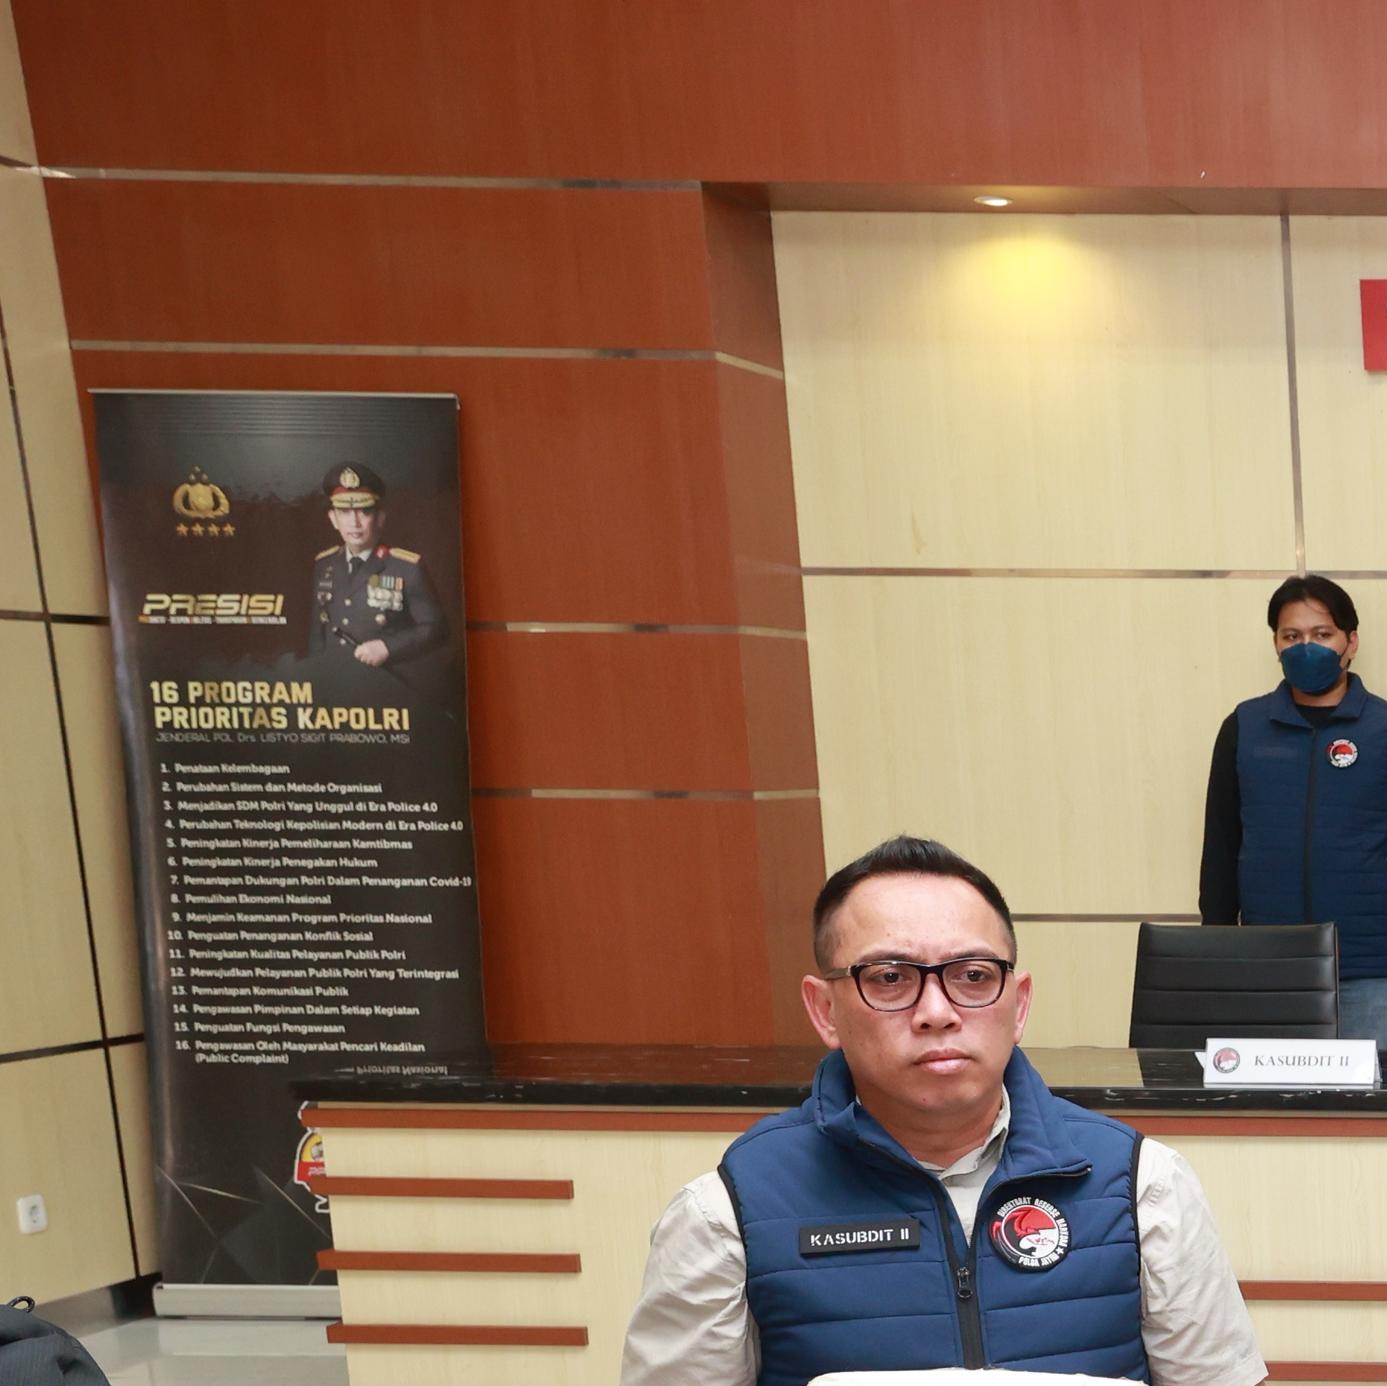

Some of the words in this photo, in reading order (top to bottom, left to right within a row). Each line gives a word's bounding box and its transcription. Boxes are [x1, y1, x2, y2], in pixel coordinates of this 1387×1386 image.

[143, 593, 284, 615] PRESISI
[150, 681, 179, 704] 16
[187, 681, 313, 704] PROGRAM
[154, 706, 288, 729] PRIORITAS
[297, 707, 410, 731] KAPOLRI
[287, 783, 326, 792] Metode
[327, 783, 382, 794] Organisasi
[261, 801, 286, 811] Polri
[287, 801, 313, 813] Yang
[315, 802, 354, 813] Unggul
[388, 802, 420, 812] Police
[245, 876, 299, 887] Dukungan
[301, 876, 325, 885] Polri
[327, 876, 360, 886] Dalam
[291, 913, 338, 924] Program
[339, 913, 384, 923] Prioritas
[385, 914, 432, 923] Nasional
[345, 950, 379, 959] Publik
[381, 950, 406, 960] Polri
[308, 968, 342, 978] Publik
[369, 969, 395, 980] Yang
[254, 1004, 305, 1016] Pimpinan
[306, 1005, 339, 1015] Dalam
[374, 1005, 420, 1017] Kegiatan
[340, 1042, 378, 1051] Pencari
[380, 1042, 425, 1052] Keadilan
[1254, 1055, 1331, 1067] KASUBDIT
[810, 1229, 893, 1246] KASUBDIT
[900, 1228, 909, 1241] II
